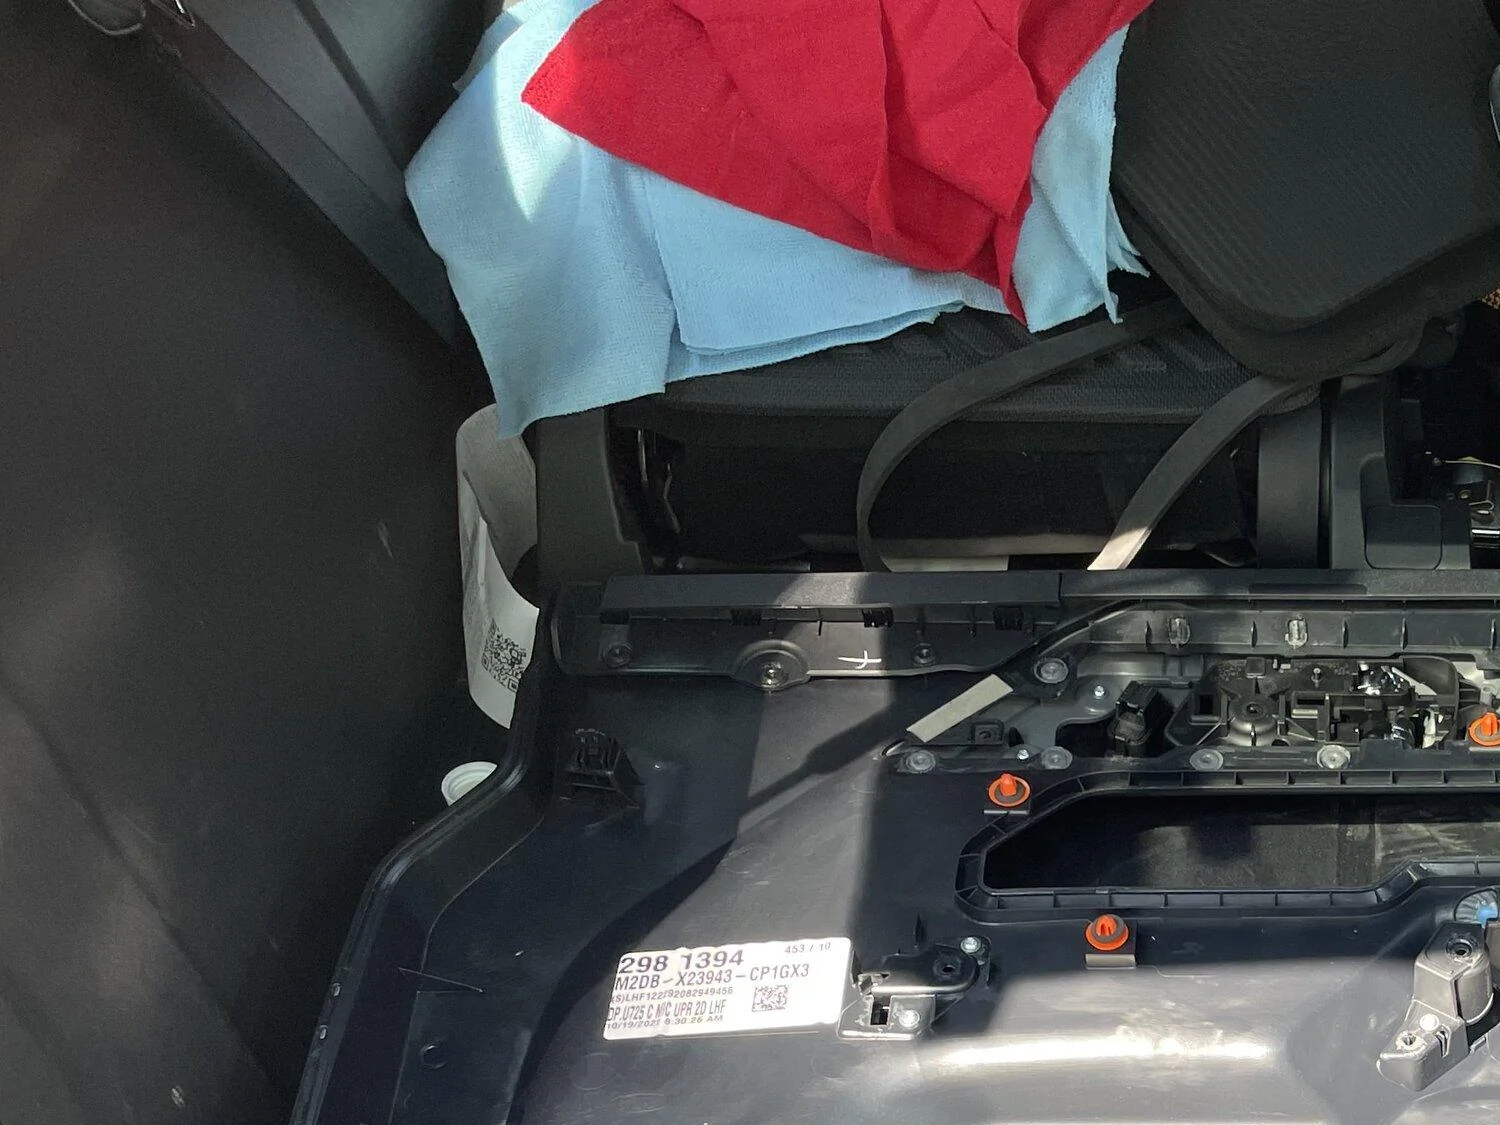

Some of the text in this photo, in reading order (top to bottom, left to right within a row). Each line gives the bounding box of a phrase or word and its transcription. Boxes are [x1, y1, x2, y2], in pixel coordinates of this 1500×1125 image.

[784, 944, 805, 954] 453
[619, 950, 744, 974] 298 1394
[673, 1000, 692, 1017] UPR
[694, 1000, 707, 1015] 2D
[709, 999, 727, 1014] LHF
[706, 1014, 723, 1022] AM
